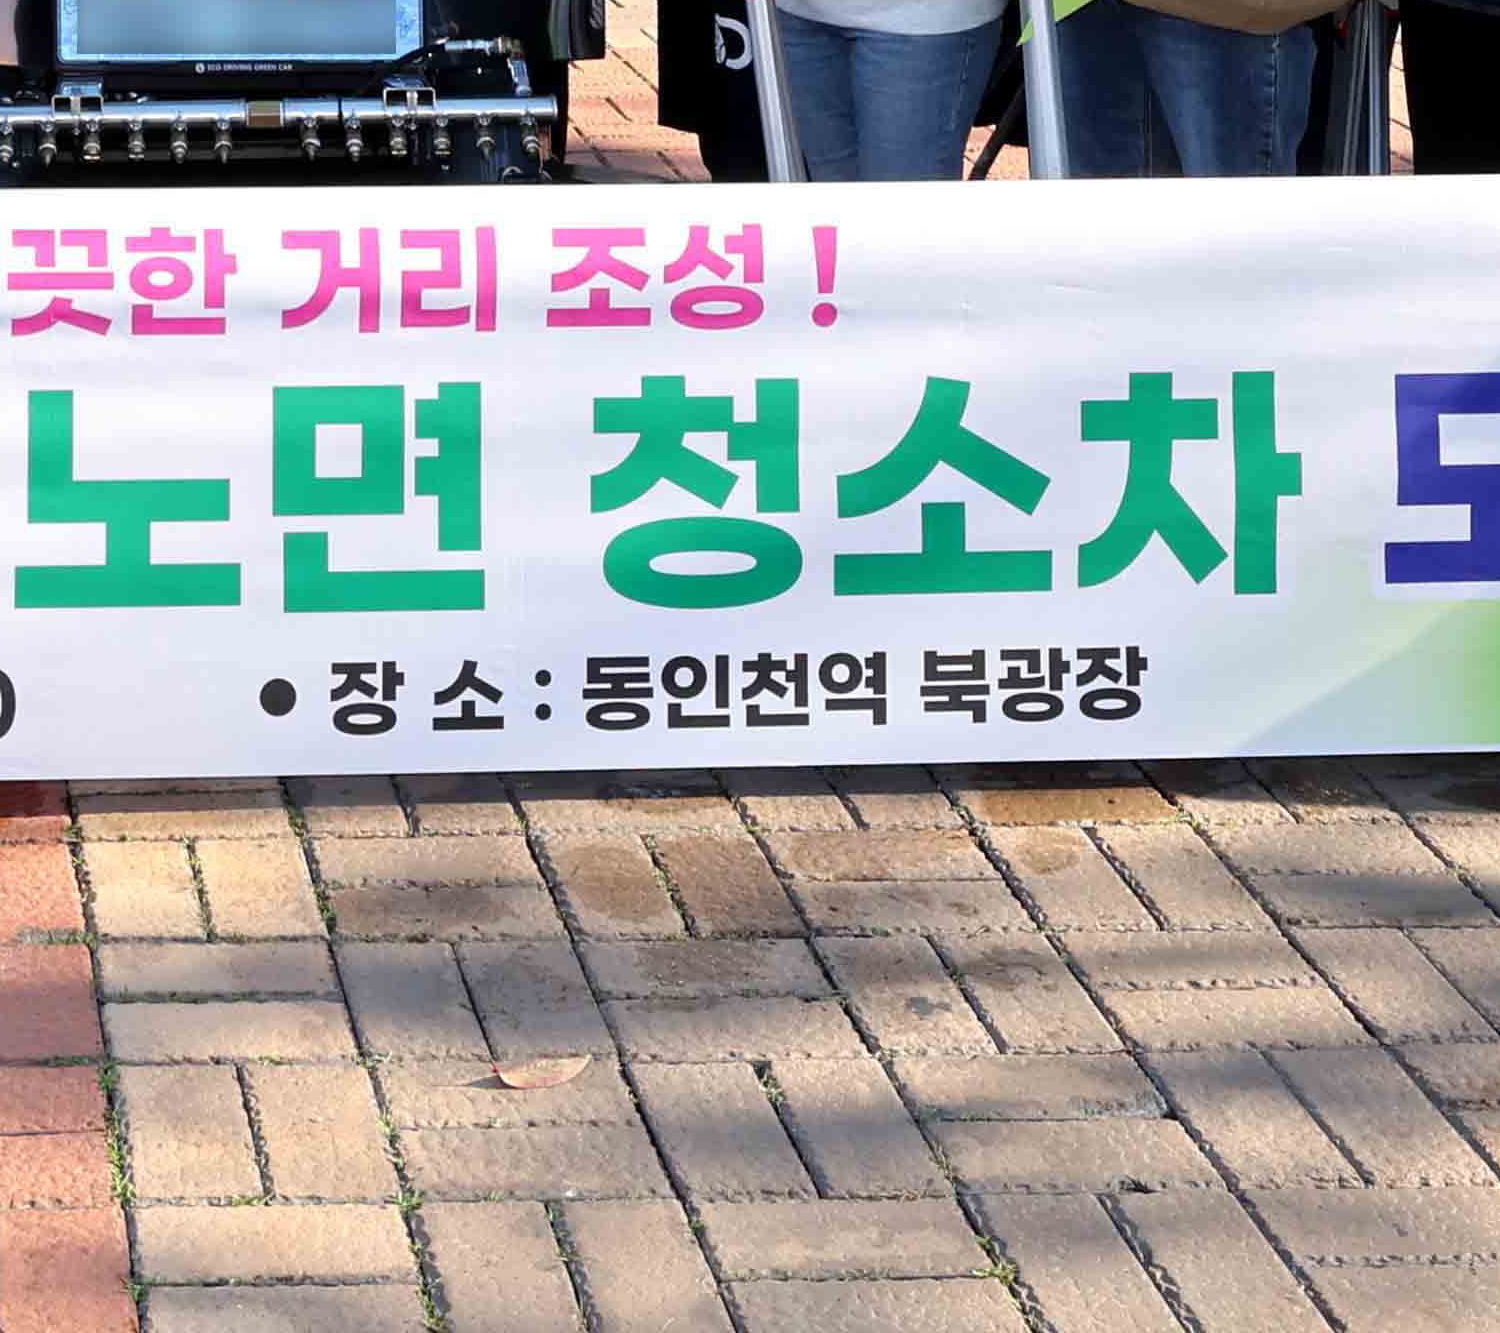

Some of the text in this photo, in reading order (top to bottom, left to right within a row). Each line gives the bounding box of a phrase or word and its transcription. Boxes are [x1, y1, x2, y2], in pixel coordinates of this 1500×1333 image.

[280, 225, 498, 335] 거리
[588, 367, 1304, 613] 청소차
[580, 651, 889, 735] 동인천역
[918, 644, 1149, 726] 북광장
